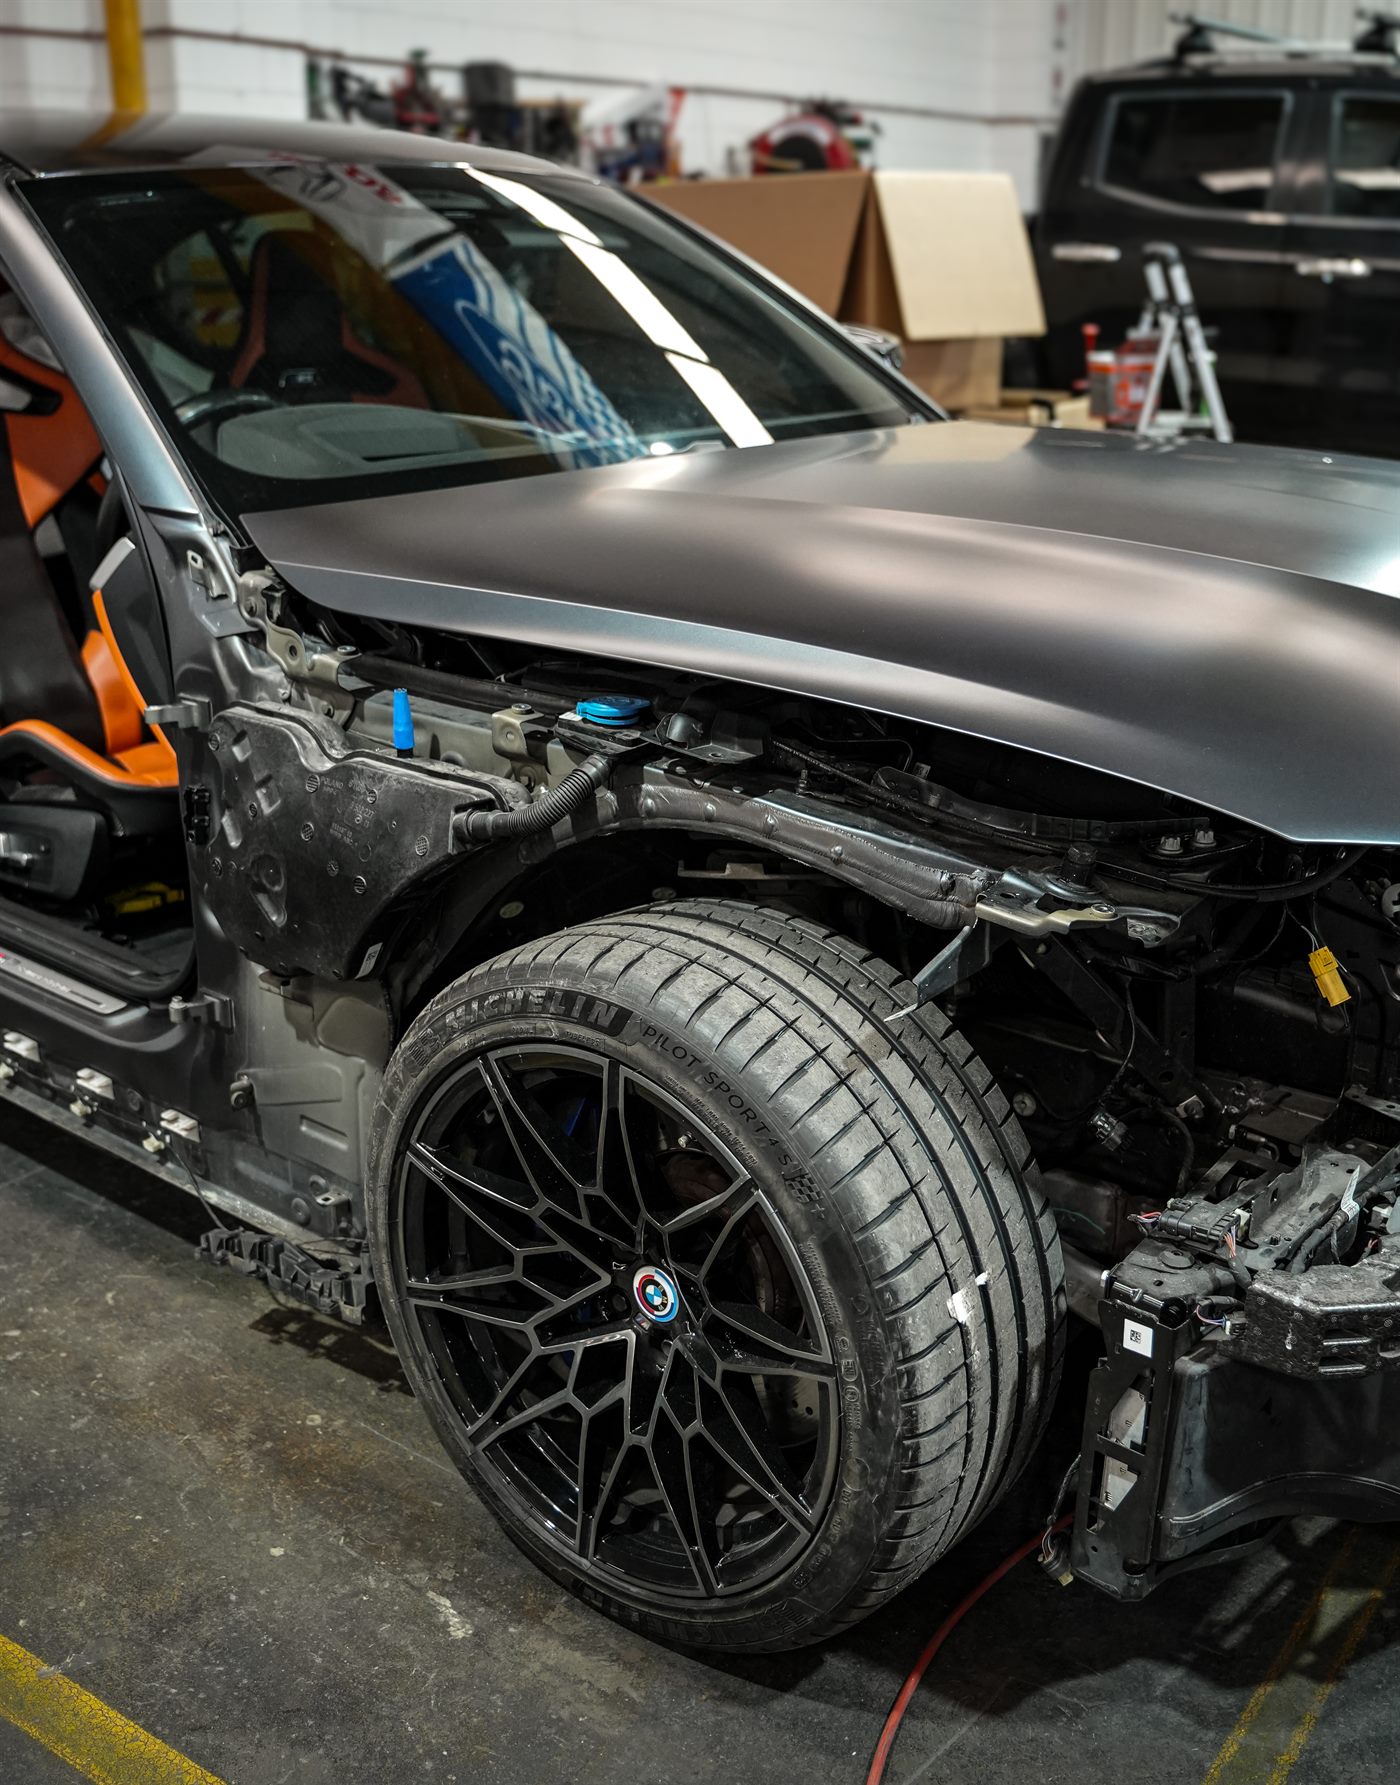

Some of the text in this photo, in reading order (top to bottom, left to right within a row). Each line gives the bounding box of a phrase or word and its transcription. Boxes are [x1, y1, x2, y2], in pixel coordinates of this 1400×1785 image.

[445, 987, 619, 1032] MICHELIN
[642, 1026, 702, 1068] PILOT
[704, 1071, 771, 1134] SPORT
[768, 1137, 780, 1148] 4
[778, 1154, 793, 1166] S
